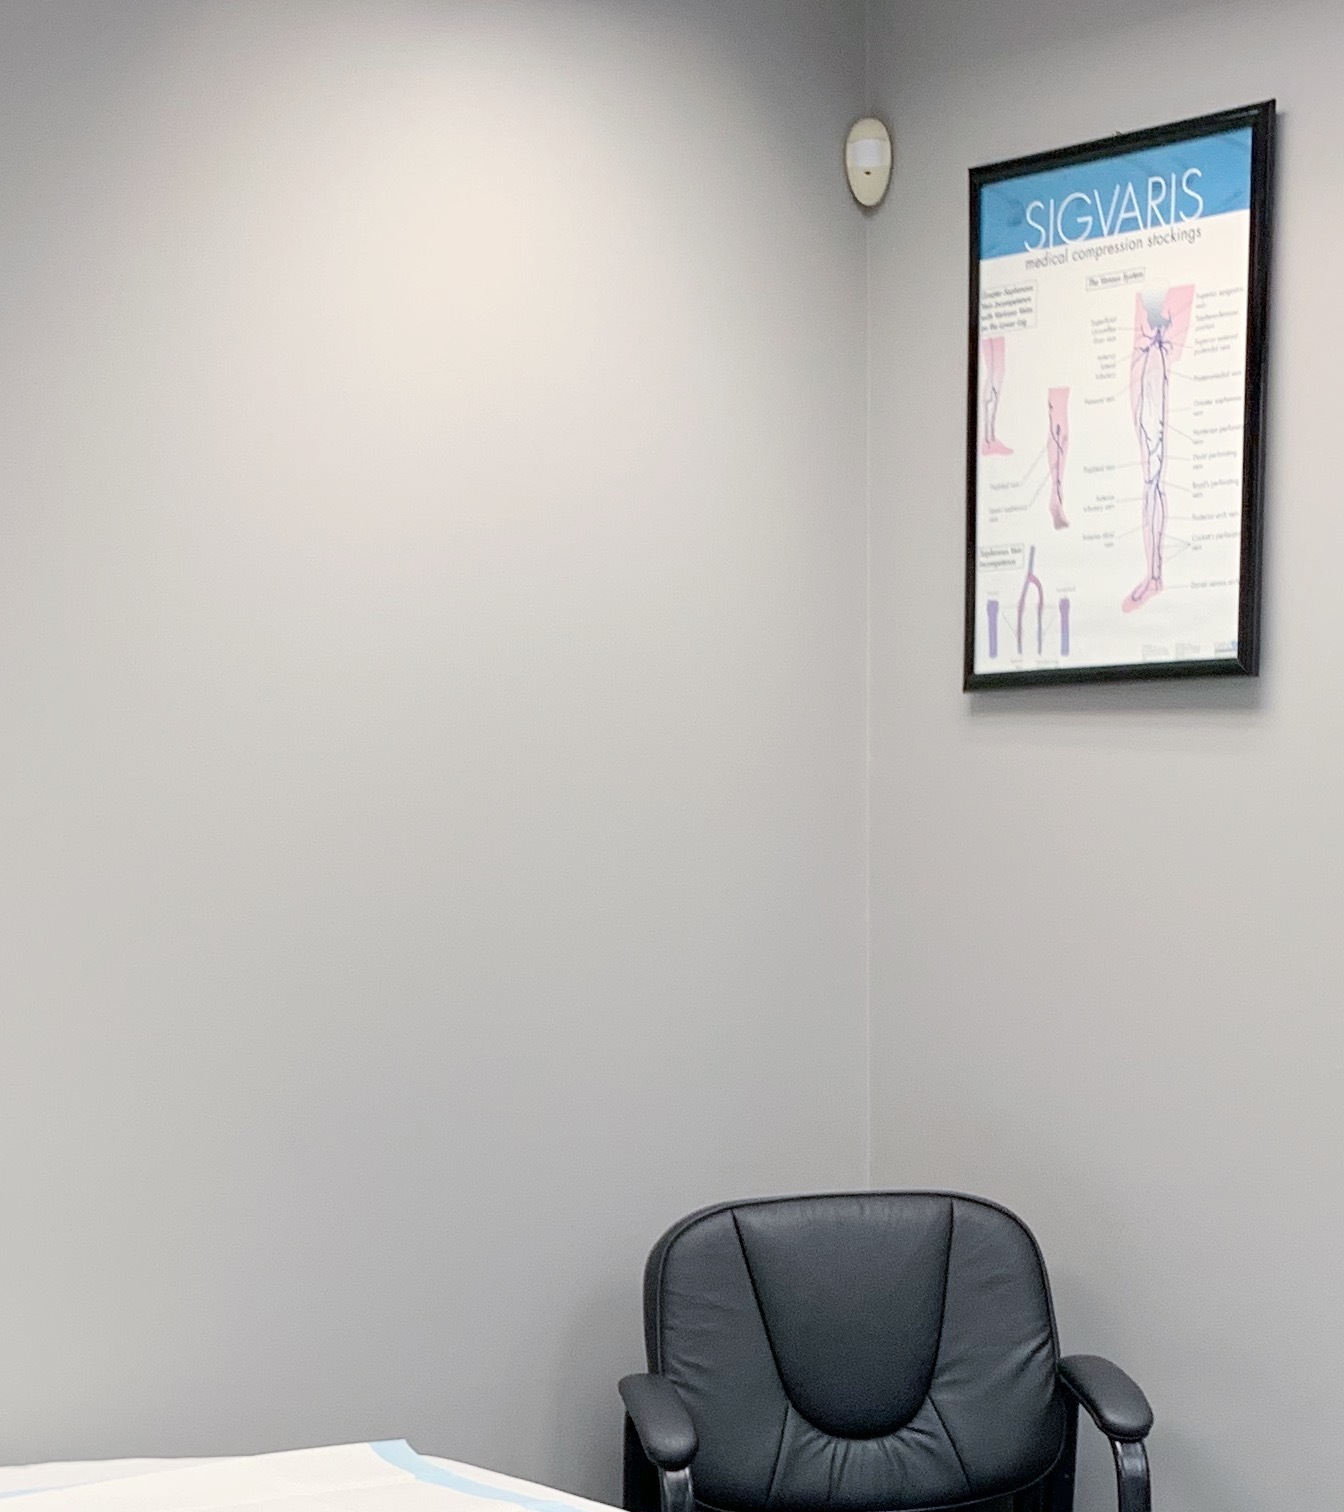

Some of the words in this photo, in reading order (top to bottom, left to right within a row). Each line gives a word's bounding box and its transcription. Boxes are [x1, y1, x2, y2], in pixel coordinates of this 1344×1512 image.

[1024, 168, 1203, 252] SIGVARIS
[1025, 248, 1068, 270] medical
[1072, 236, 1143, 261] compression
[1148, 226, 1202, 248] stockings
